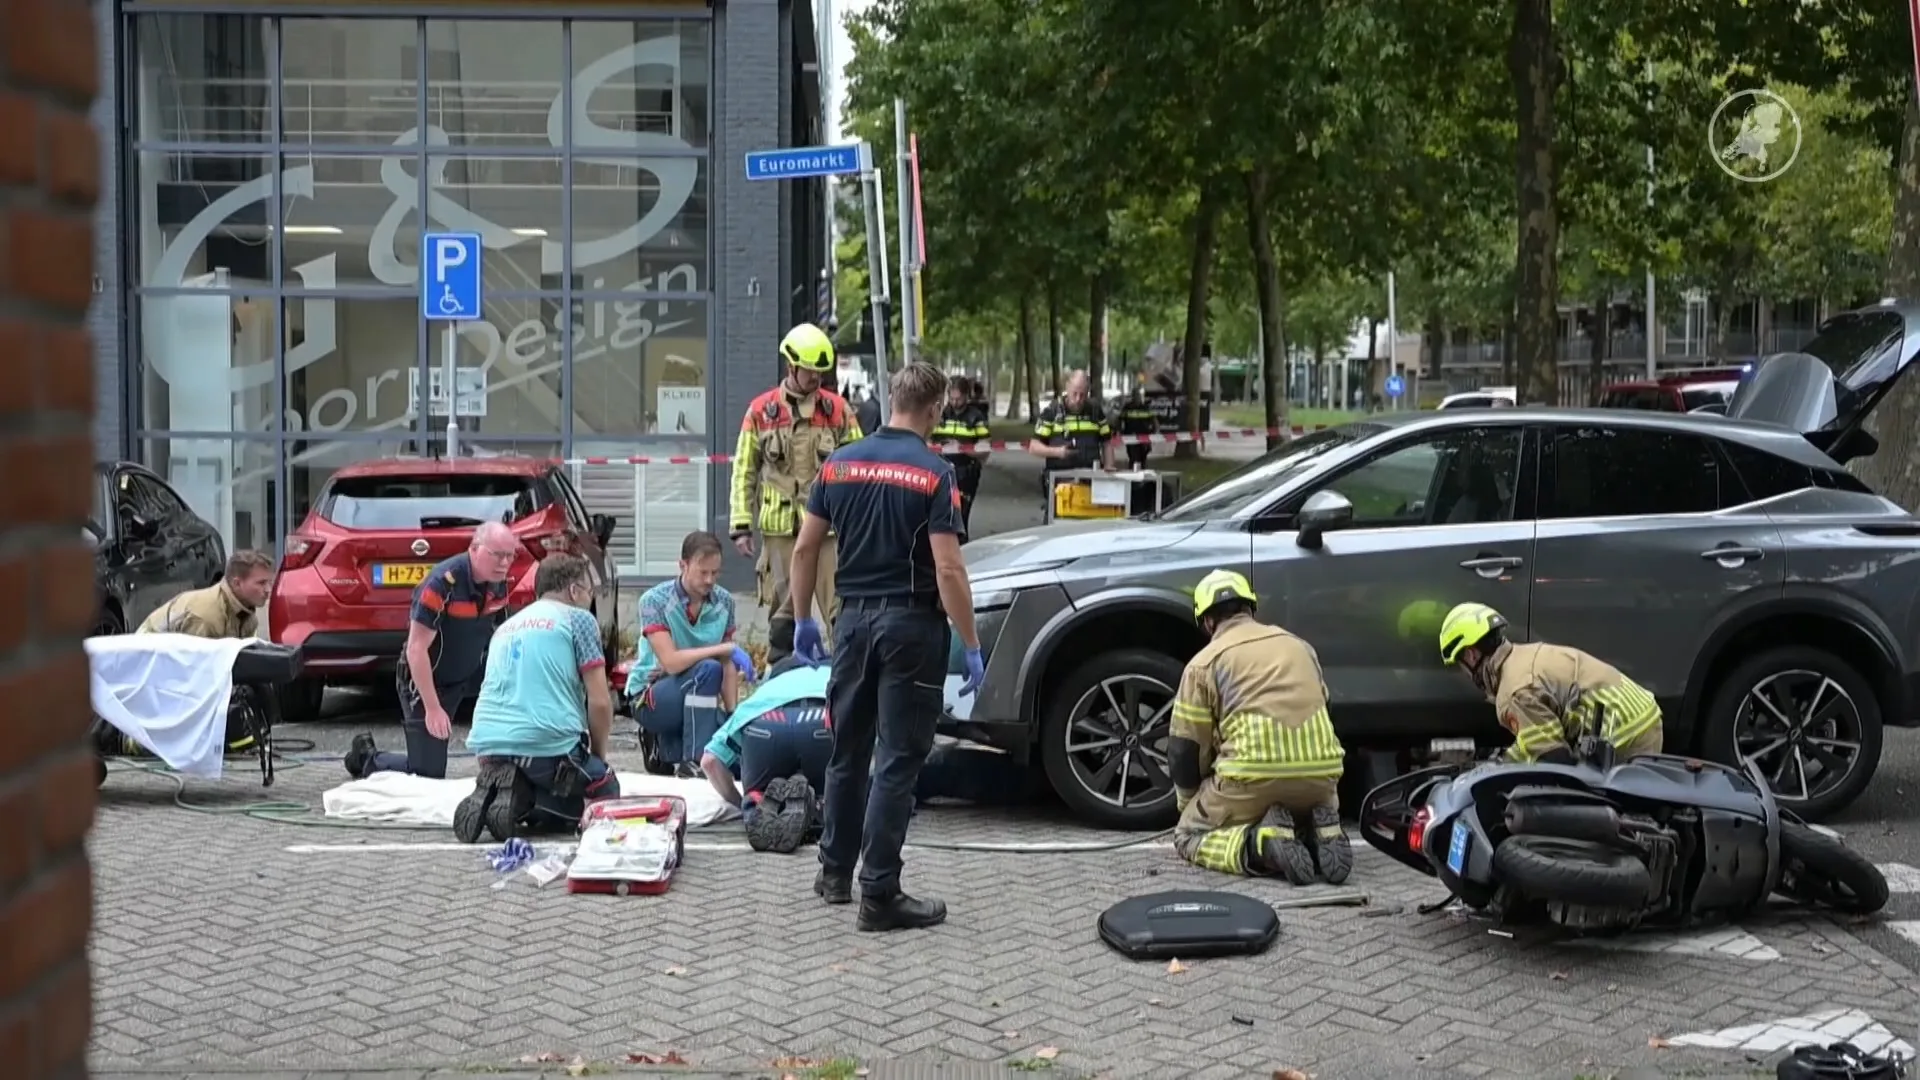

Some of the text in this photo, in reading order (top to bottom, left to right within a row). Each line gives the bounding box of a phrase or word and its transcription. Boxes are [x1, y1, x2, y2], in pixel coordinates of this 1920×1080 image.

[758, 153, 845, 173] Euromarkt
[437, 239, 467, 282] P
[850, 466, 928, 487] BRANDWEER
[387, 566, 432, 582] H-73
